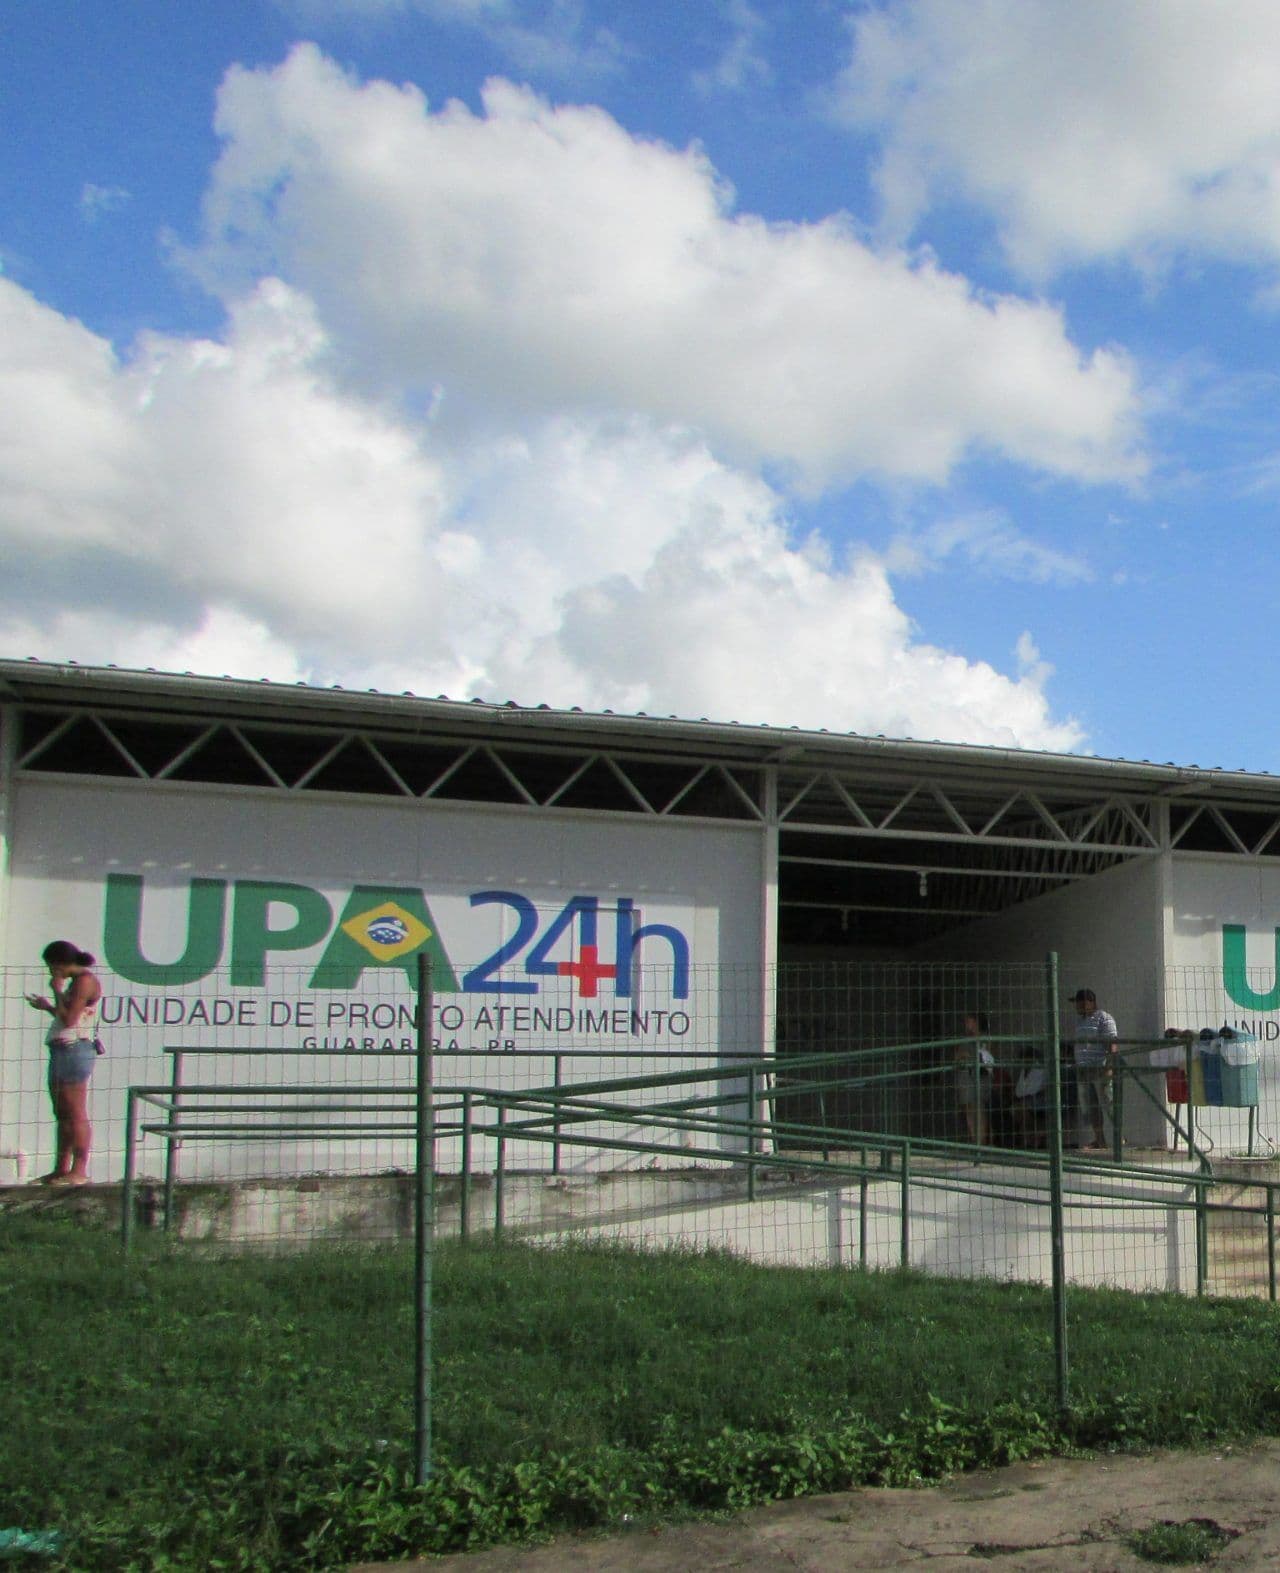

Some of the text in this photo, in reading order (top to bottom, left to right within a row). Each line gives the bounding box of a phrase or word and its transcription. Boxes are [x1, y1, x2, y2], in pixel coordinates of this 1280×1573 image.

[100, 996, 690, 1036] UNIDADE DE PRONO ATENDIMENTO
